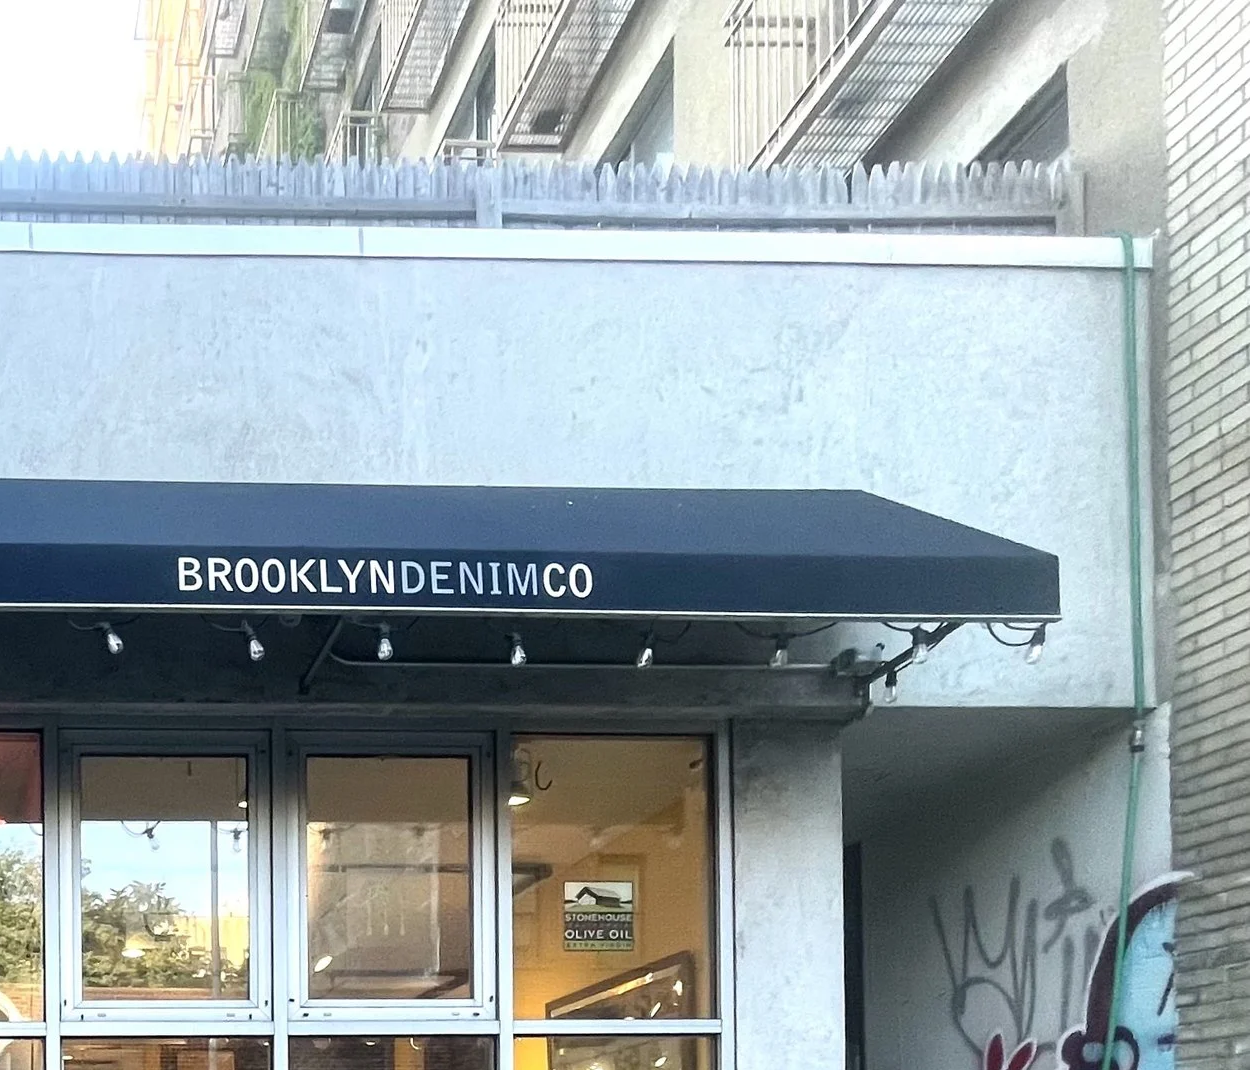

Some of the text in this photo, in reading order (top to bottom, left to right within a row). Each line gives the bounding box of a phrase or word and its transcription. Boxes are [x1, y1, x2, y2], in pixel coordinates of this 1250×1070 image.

[177, 556, 594, 599] BROOKLYNDENIMCO
[565, 913, 632, 922] STONEHOUSE
[565, 929, 633, 940] OLIVE OIL
